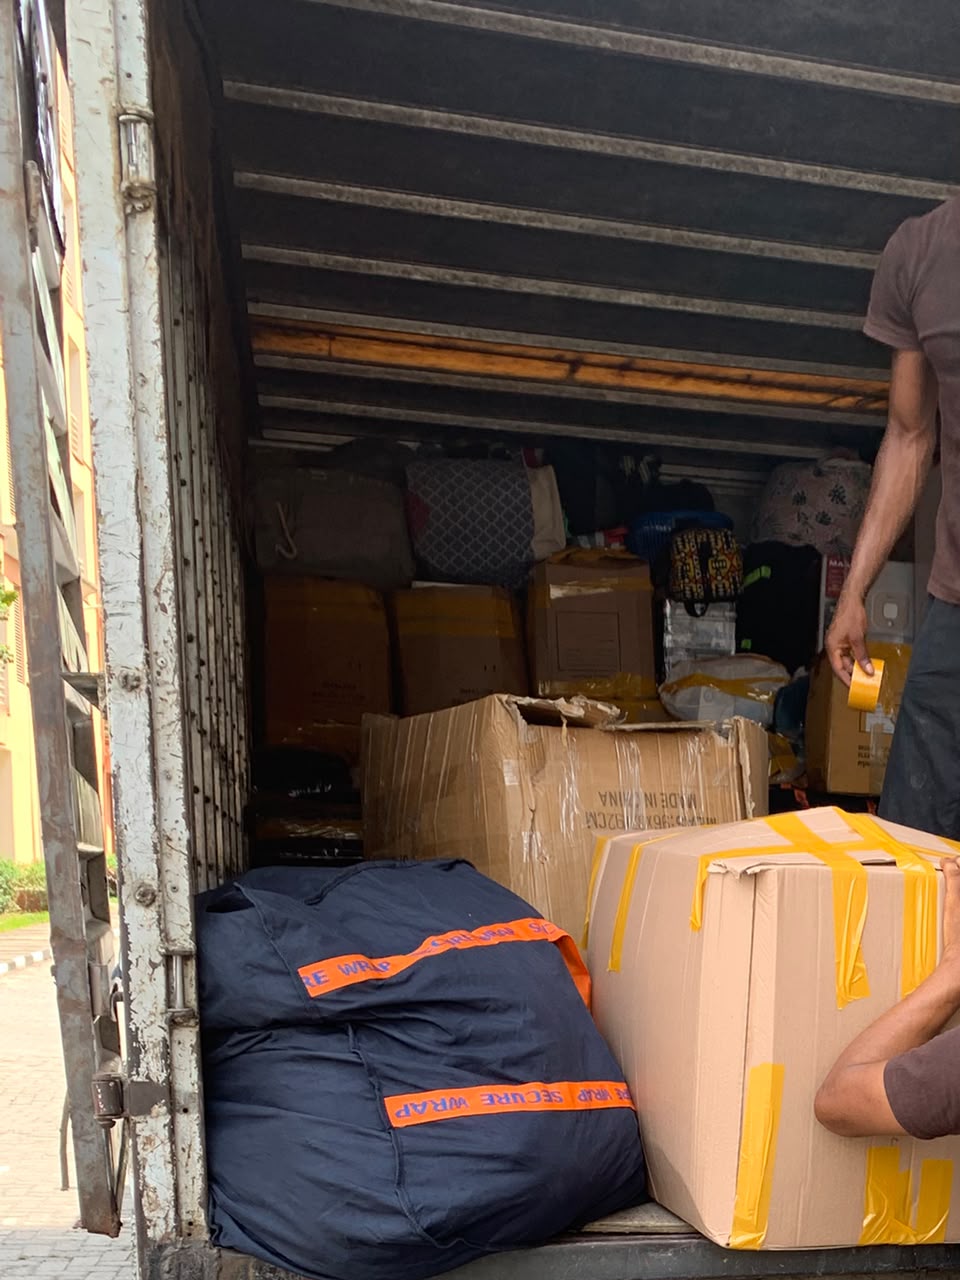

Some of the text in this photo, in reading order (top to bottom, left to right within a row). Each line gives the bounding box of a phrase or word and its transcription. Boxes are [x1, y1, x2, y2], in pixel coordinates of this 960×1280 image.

[644, 792, 658, 808] IN
[660, 792, 697, 809] MADE
[480, 1089, 564, 1105] SECURE
[395, 1097, 469, 1118] WRAP
